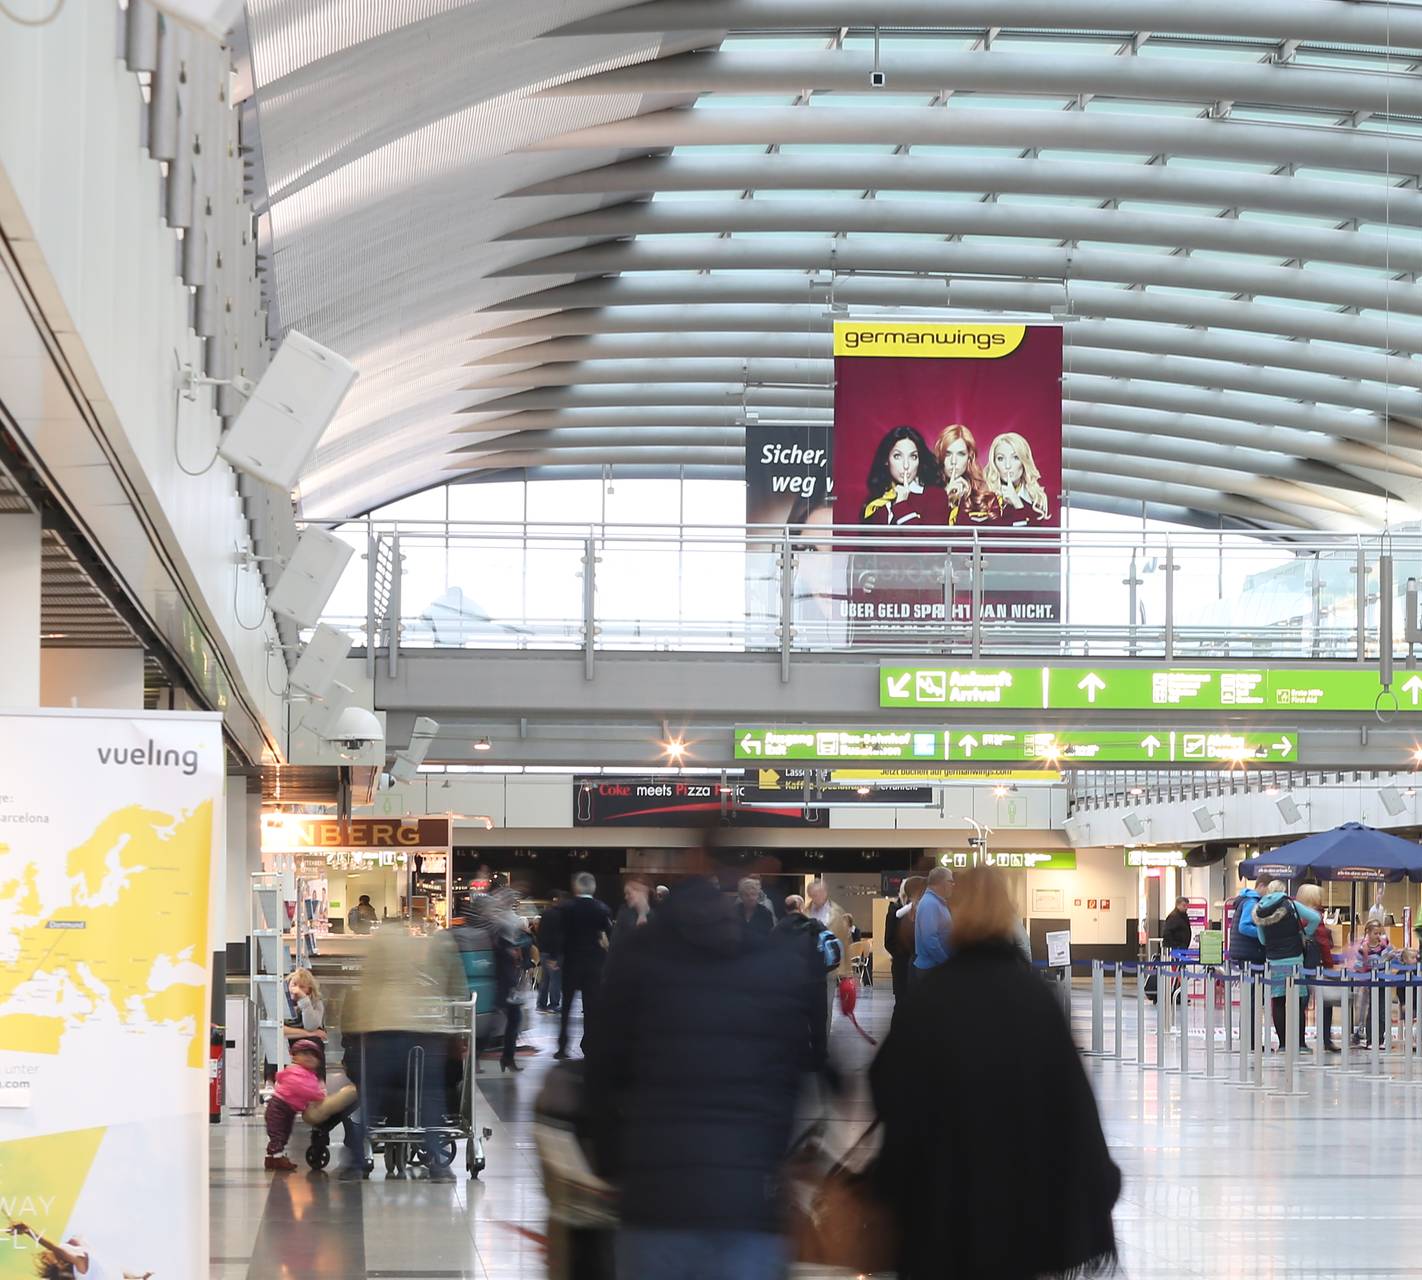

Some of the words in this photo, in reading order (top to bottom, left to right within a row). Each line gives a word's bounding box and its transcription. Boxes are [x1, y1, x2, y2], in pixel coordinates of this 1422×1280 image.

[845, 330, 1005, 350] germanwings
[761, 444, 827, 467] Sicher,
[772, 476, 816, 497] weg
[840, 600, 873, 618] ÜBER
[878, 604, 909, 618] GELD
[1011, 605, 1054, 619] NICHT.
[97, 739, 198, 775] vueling
[600, 784, 632, 796] Coke
[637, 784, 672, 796] meets
[676, 783, 711, 797] Pizza
